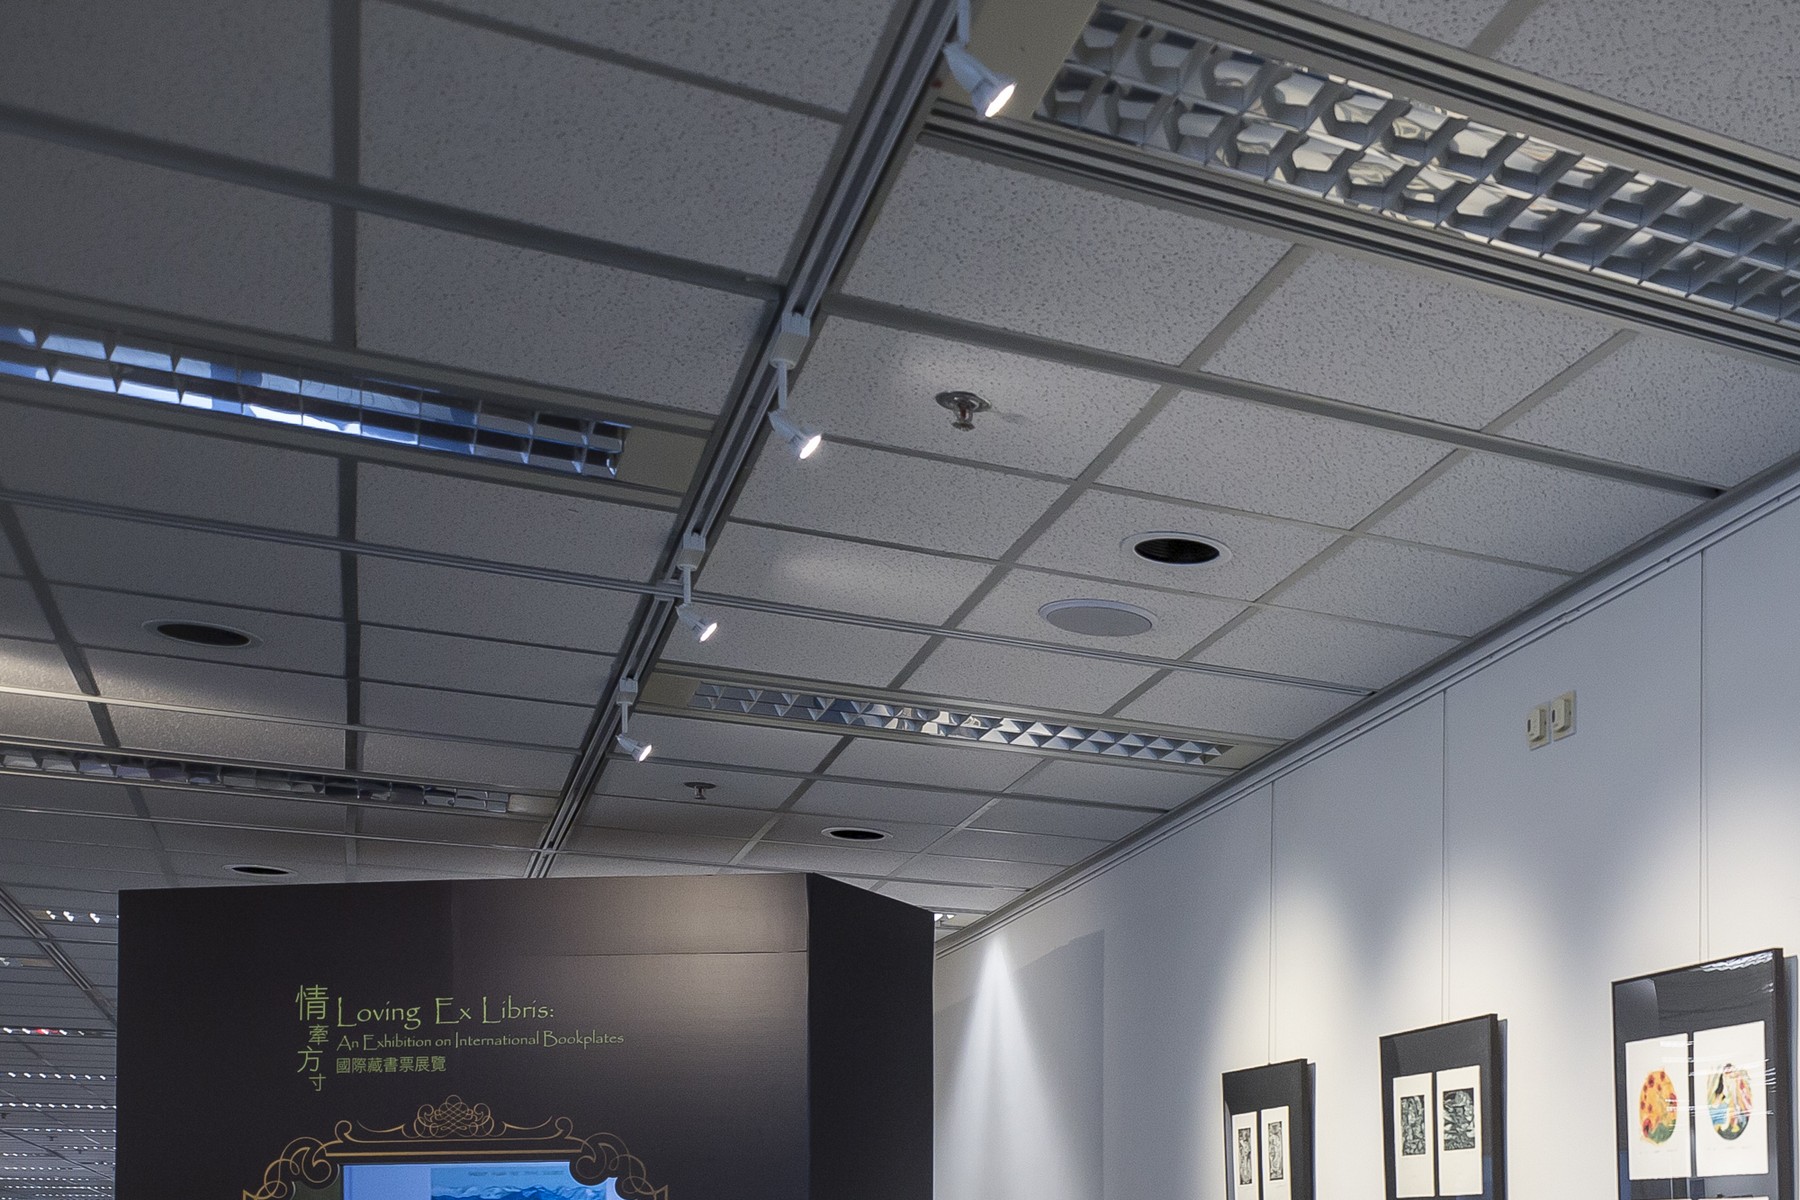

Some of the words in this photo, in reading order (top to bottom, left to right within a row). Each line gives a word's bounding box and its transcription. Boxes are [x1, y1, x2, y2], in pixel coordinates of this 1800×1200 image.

[336, 996, 421, 1030] Loving
[435, 997, 472, 1024] Ex
[482, 995, 554, 1024] Libris:
[295, 984, 329, 1092] 情牽方寸
[336, 1035, 359, 1051] An
[363, 1034, 431, 1051] Exhibition
[435, 1038, 451, 1047] on
[455, 1031, 539, 1048] International
[543, 1029, 625, 1049] Bookplates
[336, 1055, 446, 1074] 國際藏書票展覽
